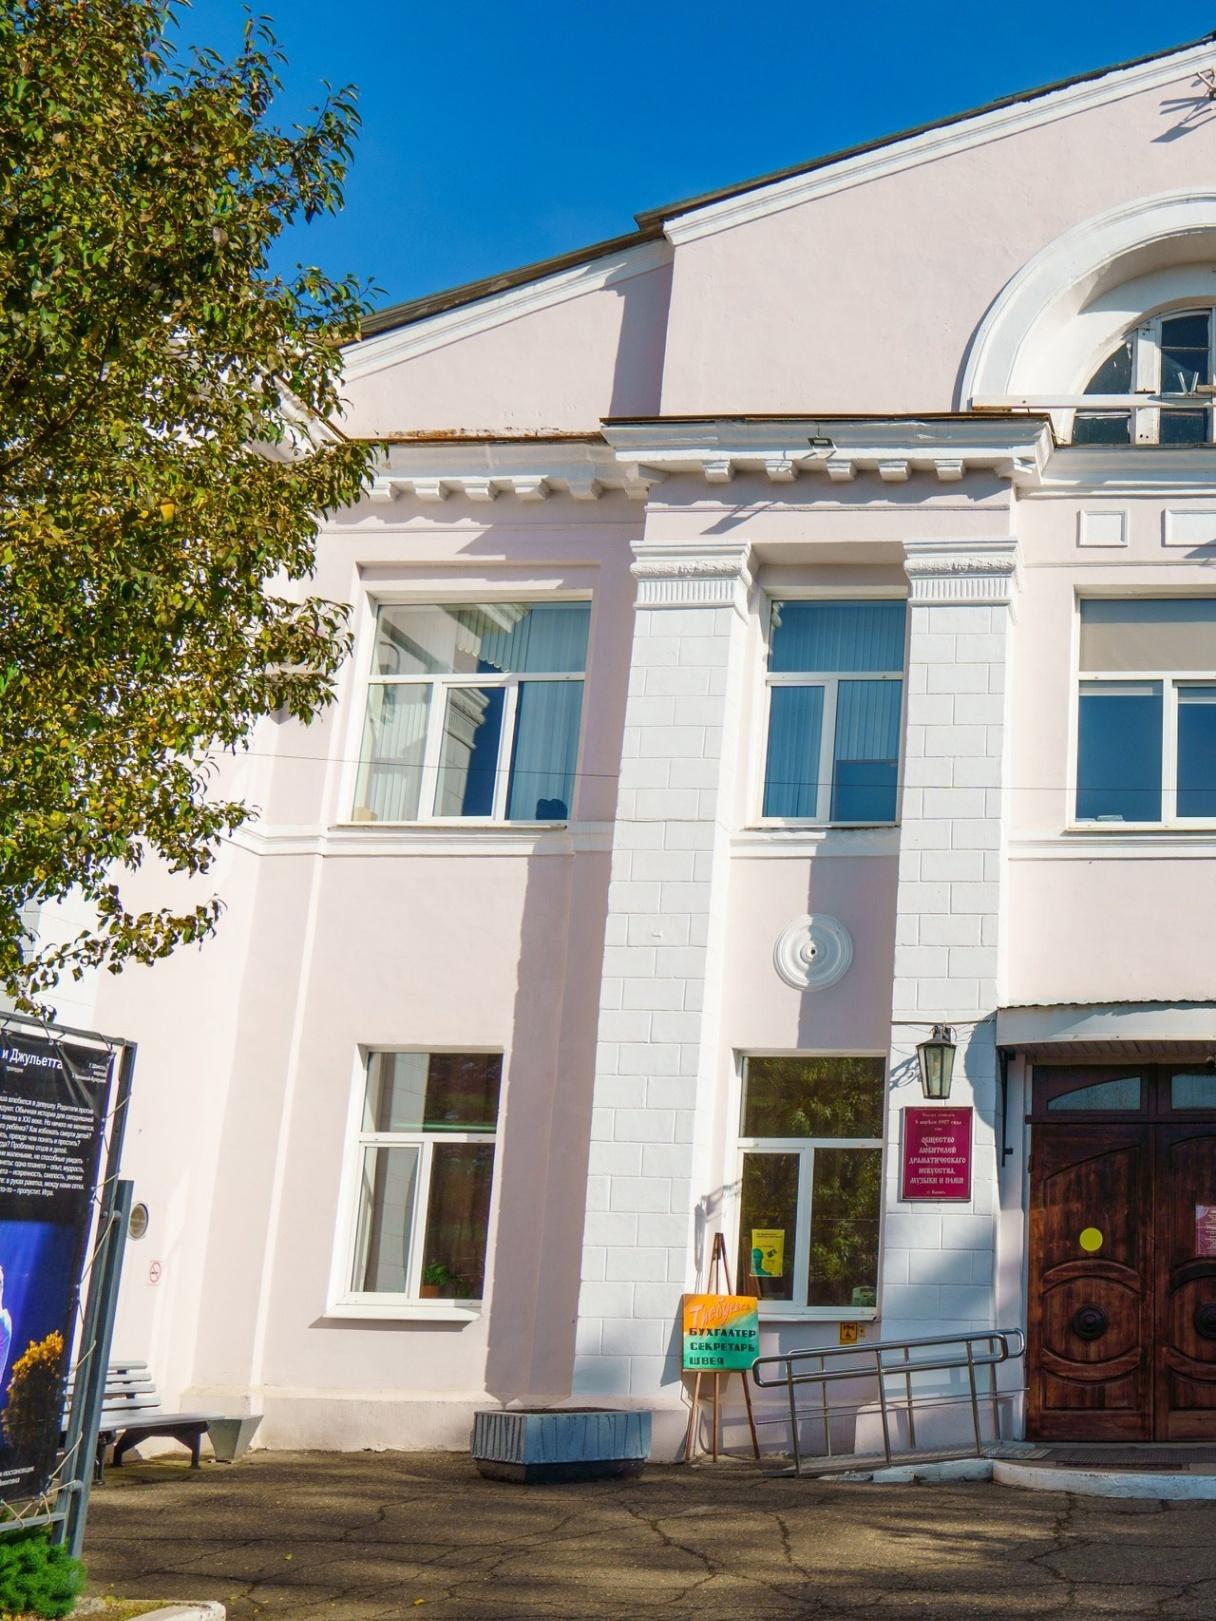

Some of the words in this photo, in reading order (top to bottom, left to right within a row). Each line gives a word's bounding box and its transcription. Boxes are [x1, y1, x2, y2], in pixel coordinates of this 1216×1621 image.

[2, 1049, 8, 1059] и
[9, 1048, 64, 1070] Джульетта
[689, 1327, 756, 1338] БУХГАЛТЕР
[690, 1342, 755, 1352] СЕКРЕТАРЬ
[689, 1356, 725, 1365] ШВЕЯ
